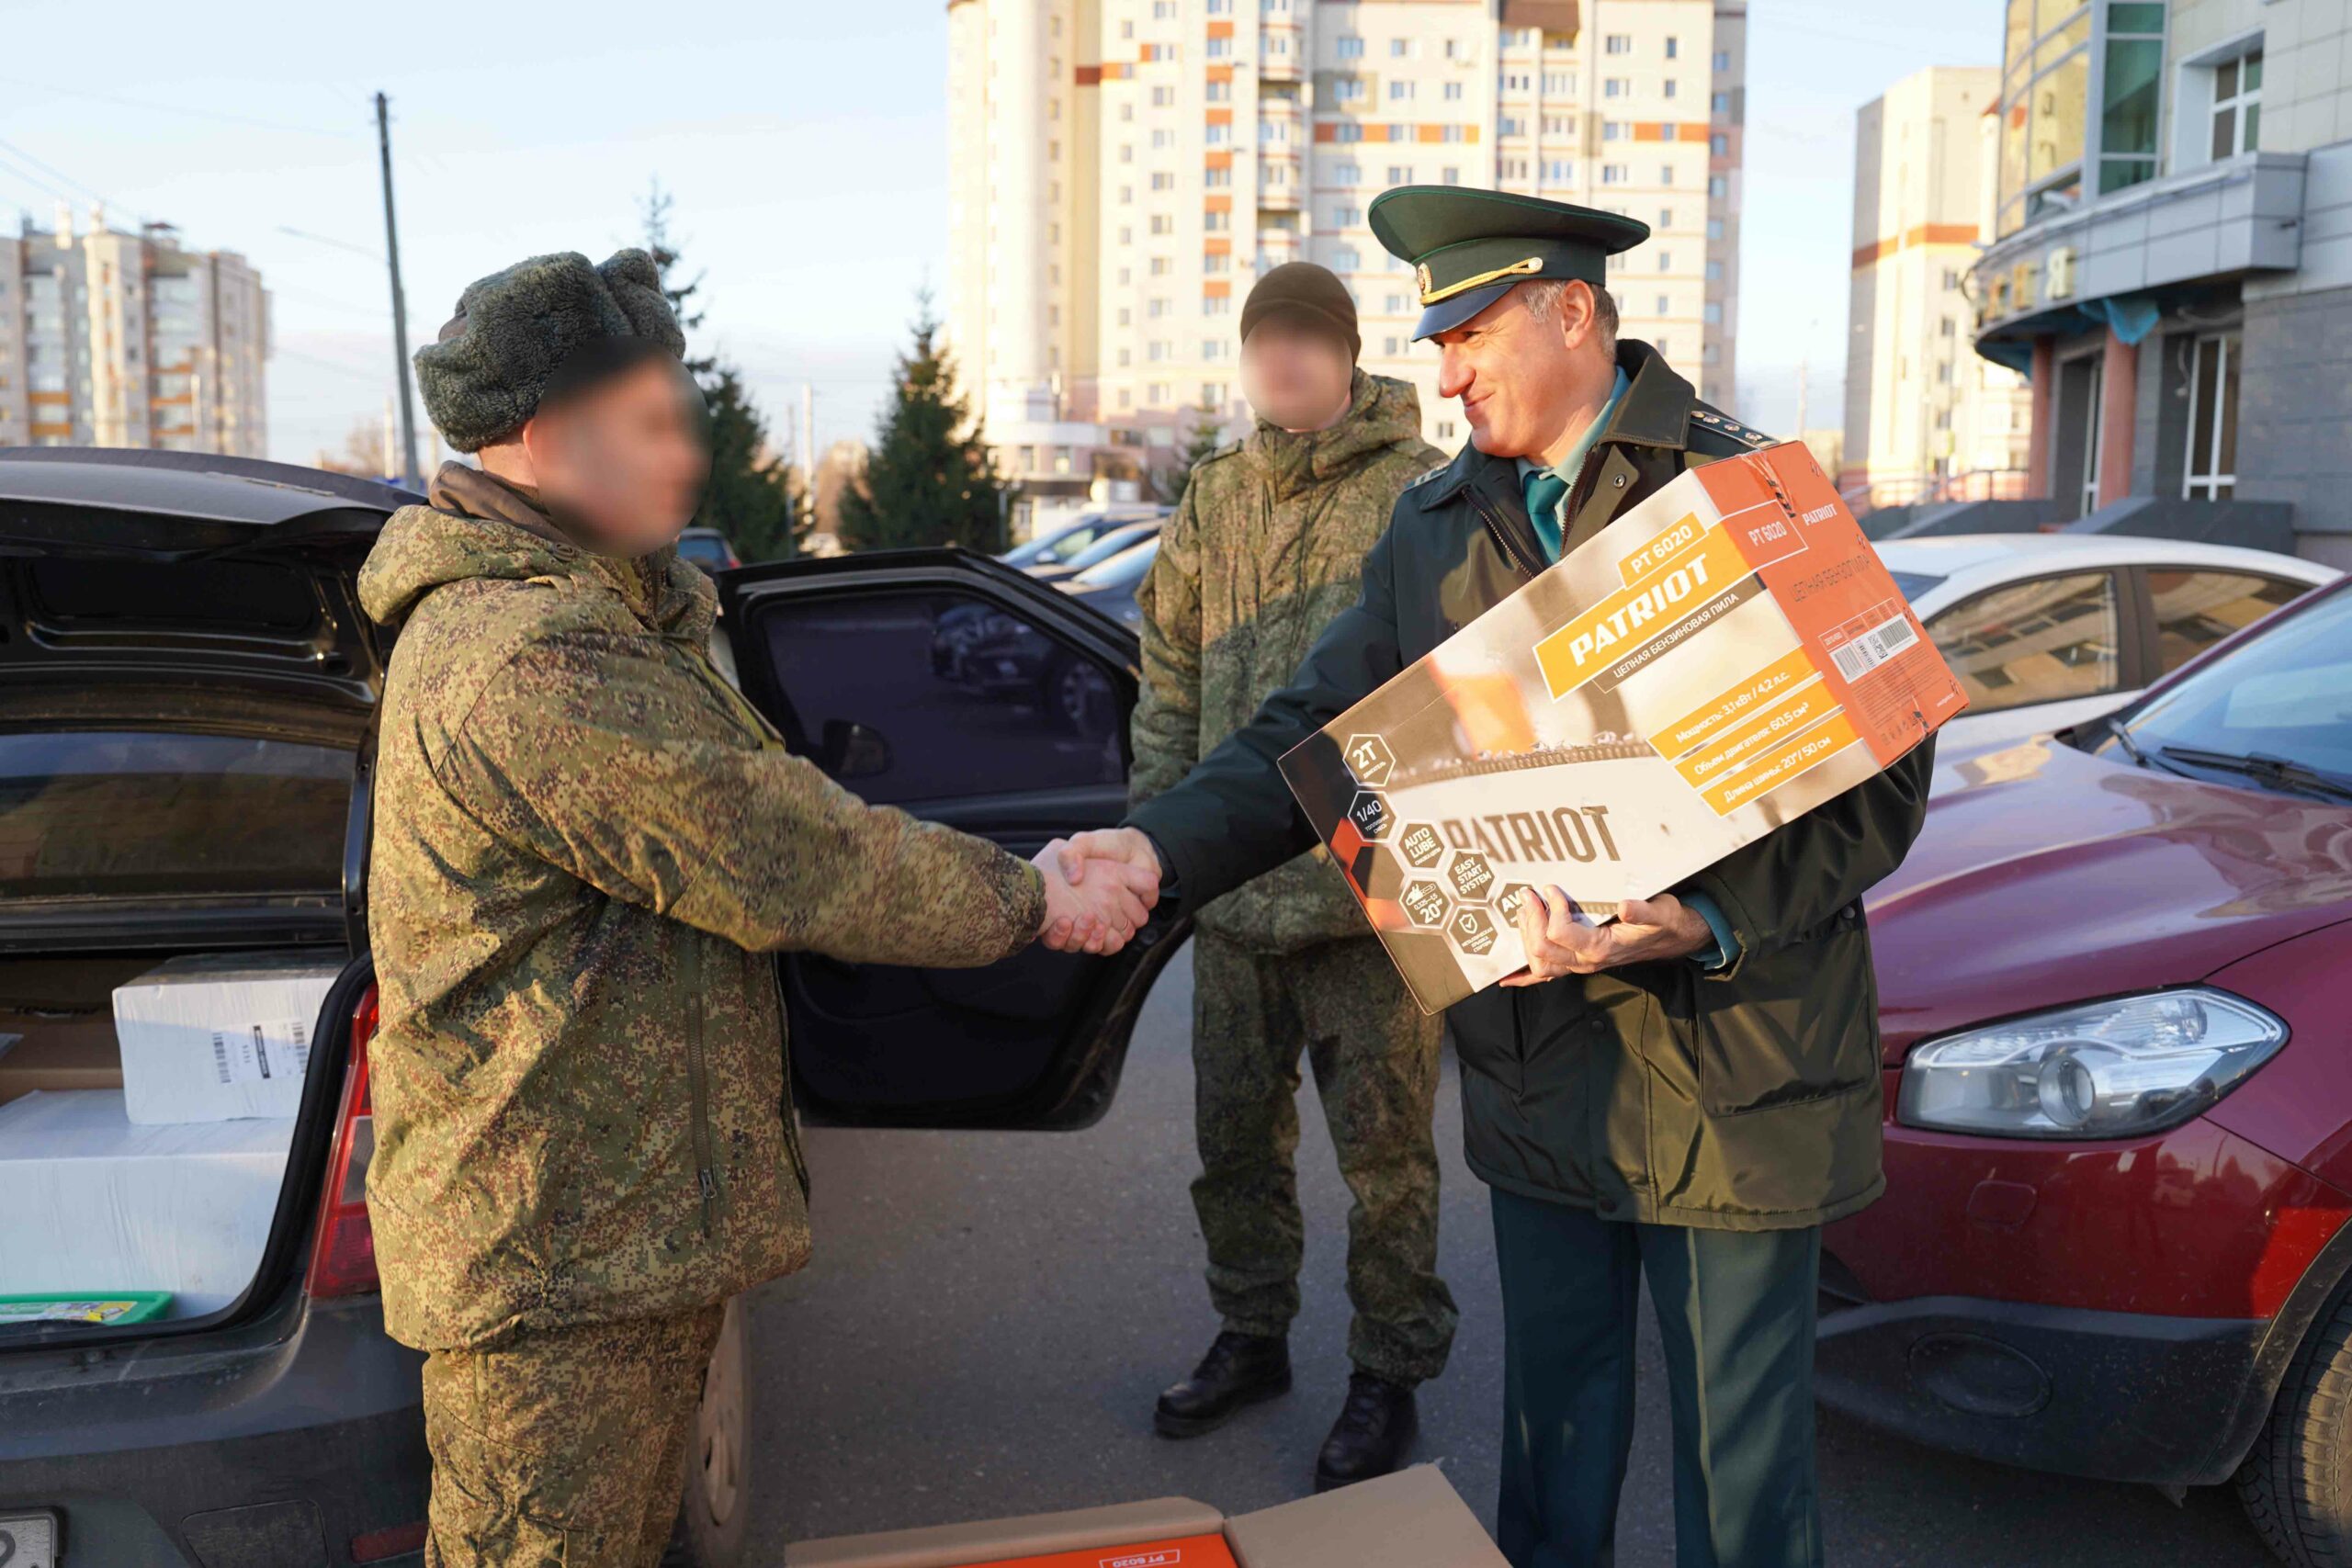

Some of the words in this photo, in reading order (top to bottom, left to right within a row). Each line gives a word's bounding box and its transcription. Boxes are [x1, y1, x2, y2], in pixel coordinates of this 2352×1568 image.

[1802, 503, 1838, 526] PATRIOT
[1747, 527, 1765, 547] PT
[1761, 521, 1788, 542] 6020
[1631, 553, 1652, 574] PT
[1653, 525, 1693, 559] 6020
[1569, 553, 1709, 667] PATRIOT
[1613, 649, 1651, 679] ЦЕПНАЯ
[1650, 611, 1711, 655] БЕНЗИНОВАЯ
[1710, 592, 1739, 619] ПИЛА
[1675, 713, 1724, 743] Мощность:
[1758, 678, 1775, 694] 4,2
[1770, 711, 1794, 732] 60,5
[1724, 782, 1754, 803] Длина
[1802, 742, 1816, 758] 50
[1816, 736, 1832, 750] см
[1356, 799, 1383, 822] 1/40
[1404, 827, 1430, 850] AUTO
[1441, 806, 1621, 863] PATRIOT
[1409, 837, 1436, 860] LUBE
[1454, 856, 1476, 874] EASY
[1457, 863, 1483, 885] START
[1460, 871, 1492, 895] SYSTEM
[1500, 886, 1529, 912] AV
